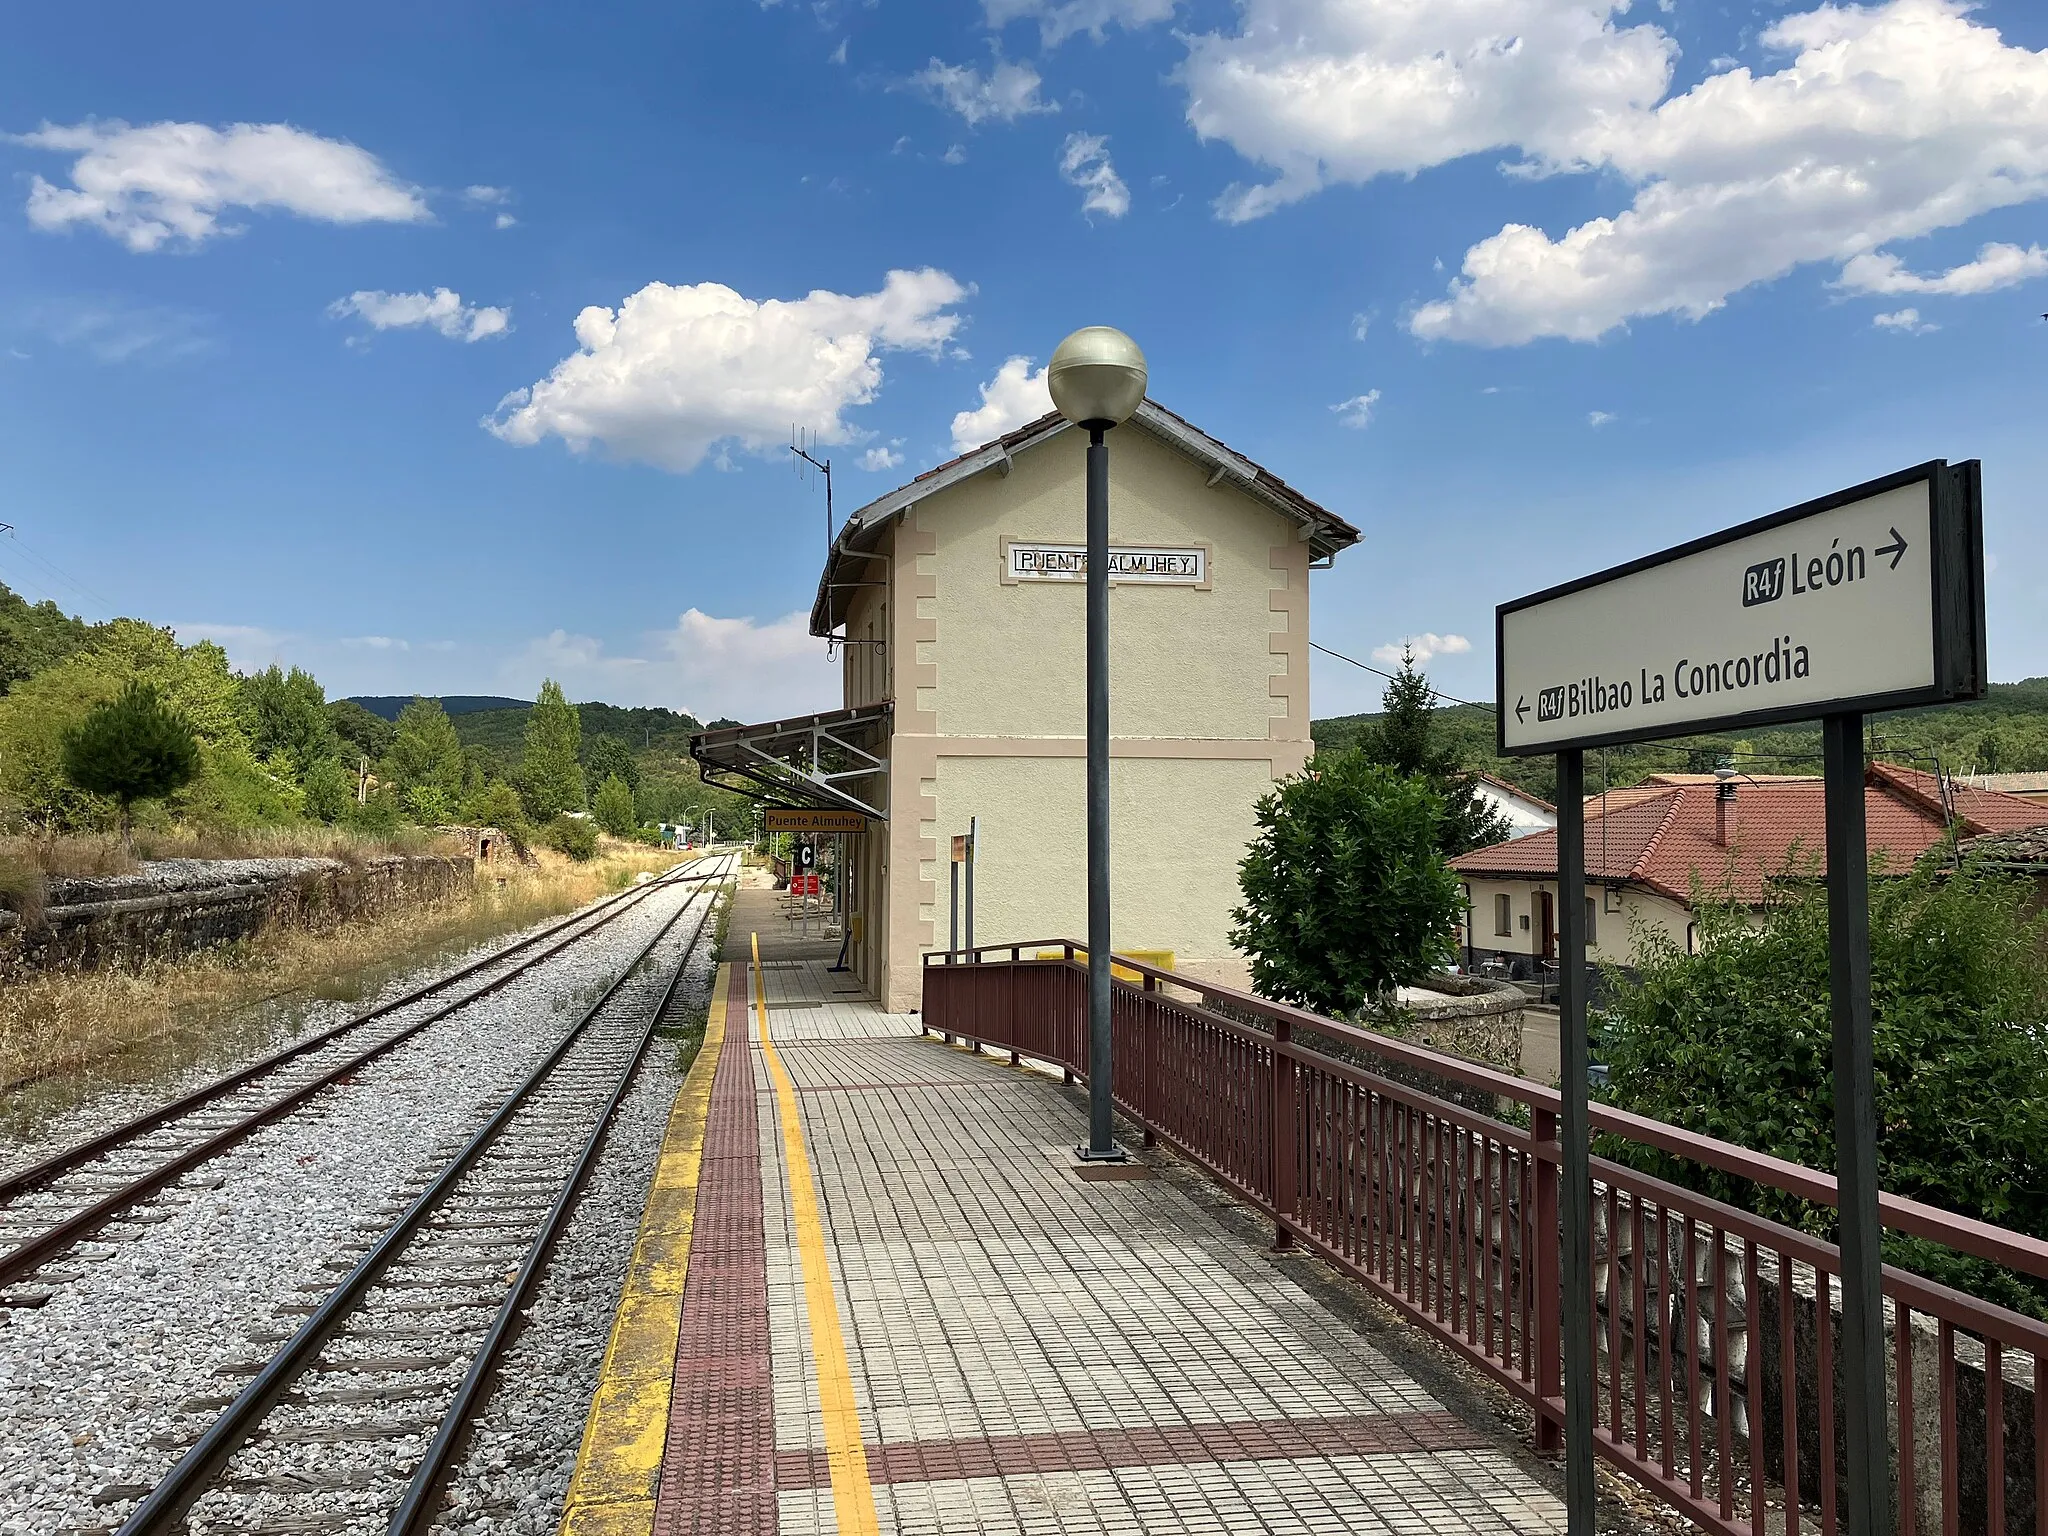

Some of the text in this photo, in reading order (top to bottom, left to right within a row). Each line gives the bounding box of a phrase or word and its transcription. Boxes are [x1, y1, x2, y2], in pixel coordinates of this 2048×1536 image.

[1108, 555, 1190, 573] ALMUHEY
[1746, 537, 1866, 601] R4f León
[1540, 635, 1810, 718] R4f Bilbao La Concordia
[768, 815, 861, 829] Puente Almuhey
[801, 846, 811, 865] C
